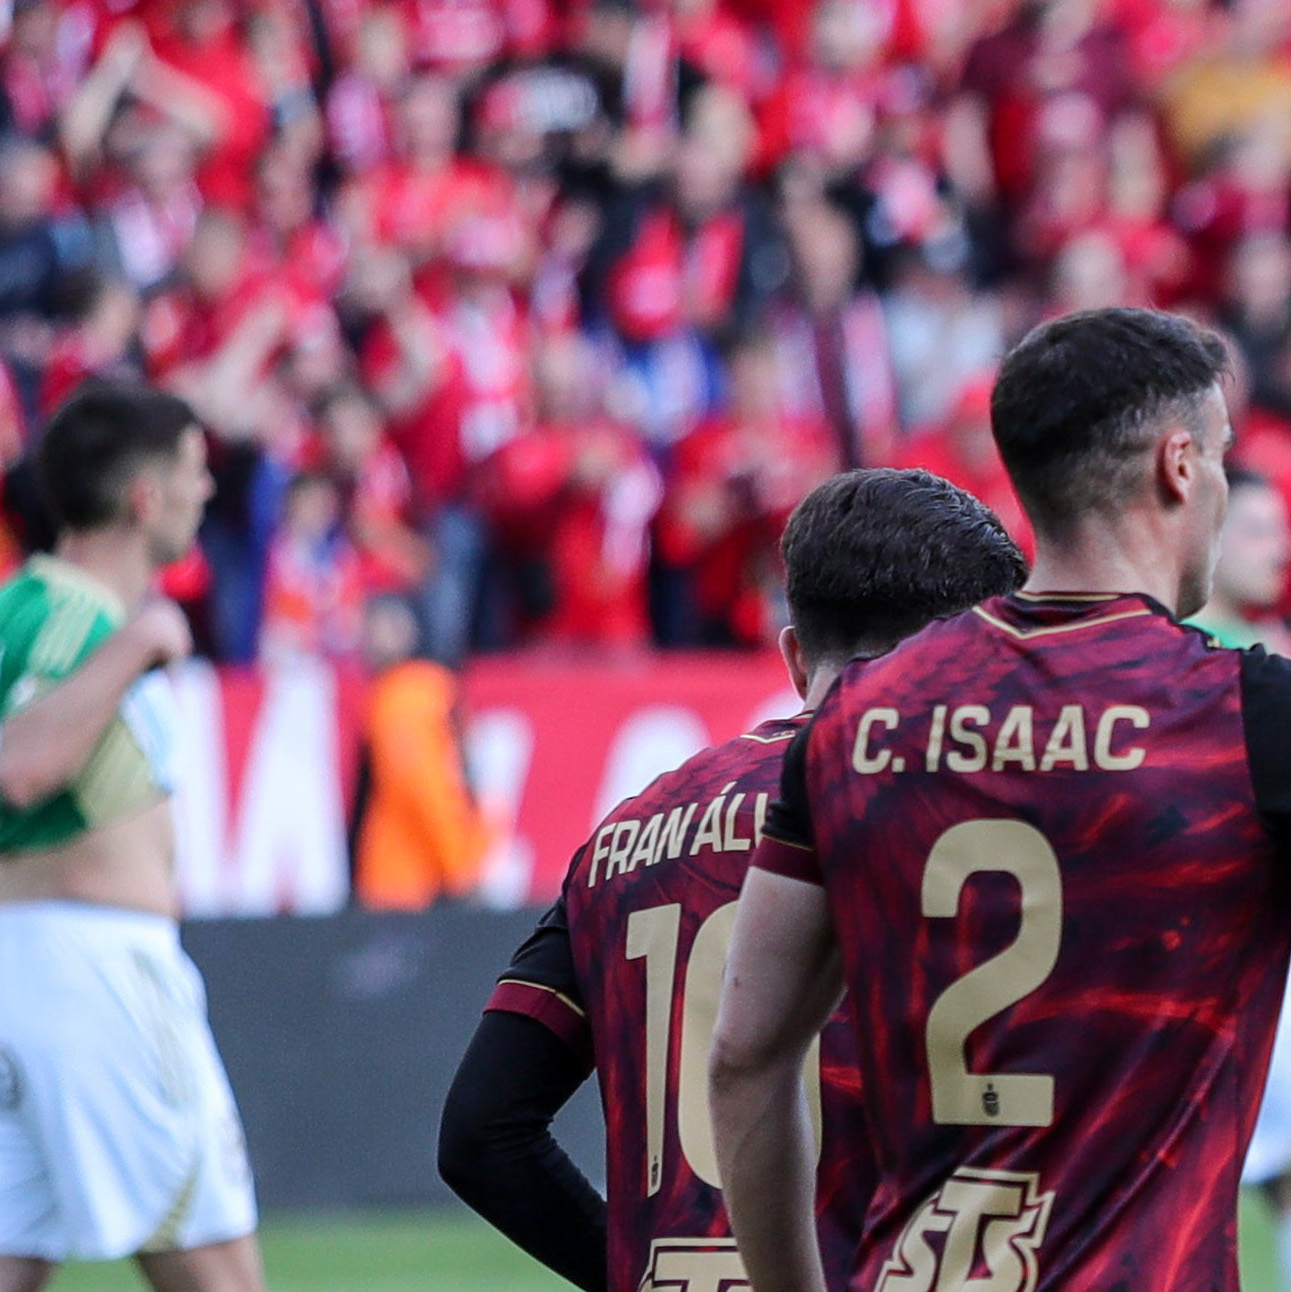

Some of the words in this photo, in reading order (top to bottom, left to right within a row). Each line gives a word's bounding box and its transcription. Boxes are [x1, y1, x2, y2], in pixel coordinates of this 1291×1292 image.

[852, 706, 904, 774] C.
[925, 705, 1150, 773] ISAAC
[588, 802, 699, 888] FRAN
[922, 819, 1063, 1127] 2
